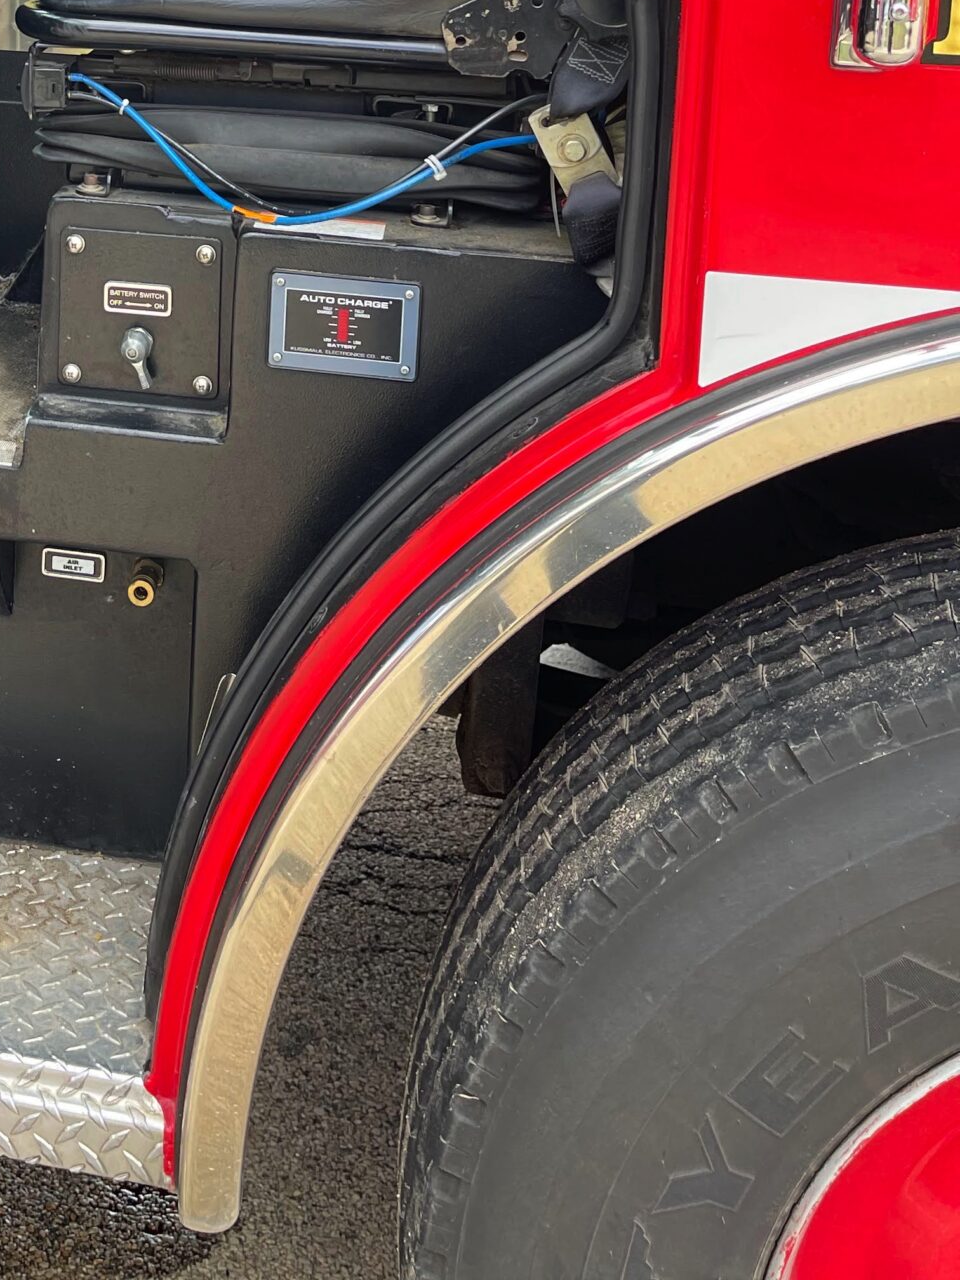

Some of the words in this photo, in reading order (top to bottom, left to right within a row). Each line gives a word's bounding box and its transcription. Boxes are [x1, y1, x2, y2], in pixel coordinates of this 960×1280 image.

[109, 289, 138, 297] BATTERY
[139, 292, 165, 300] SWITCH
[299, 294, 335, 305] AUTO
[337, 297, 389, 309] CHARGE
[325, 349, 366, 358] ELECTRONICS
